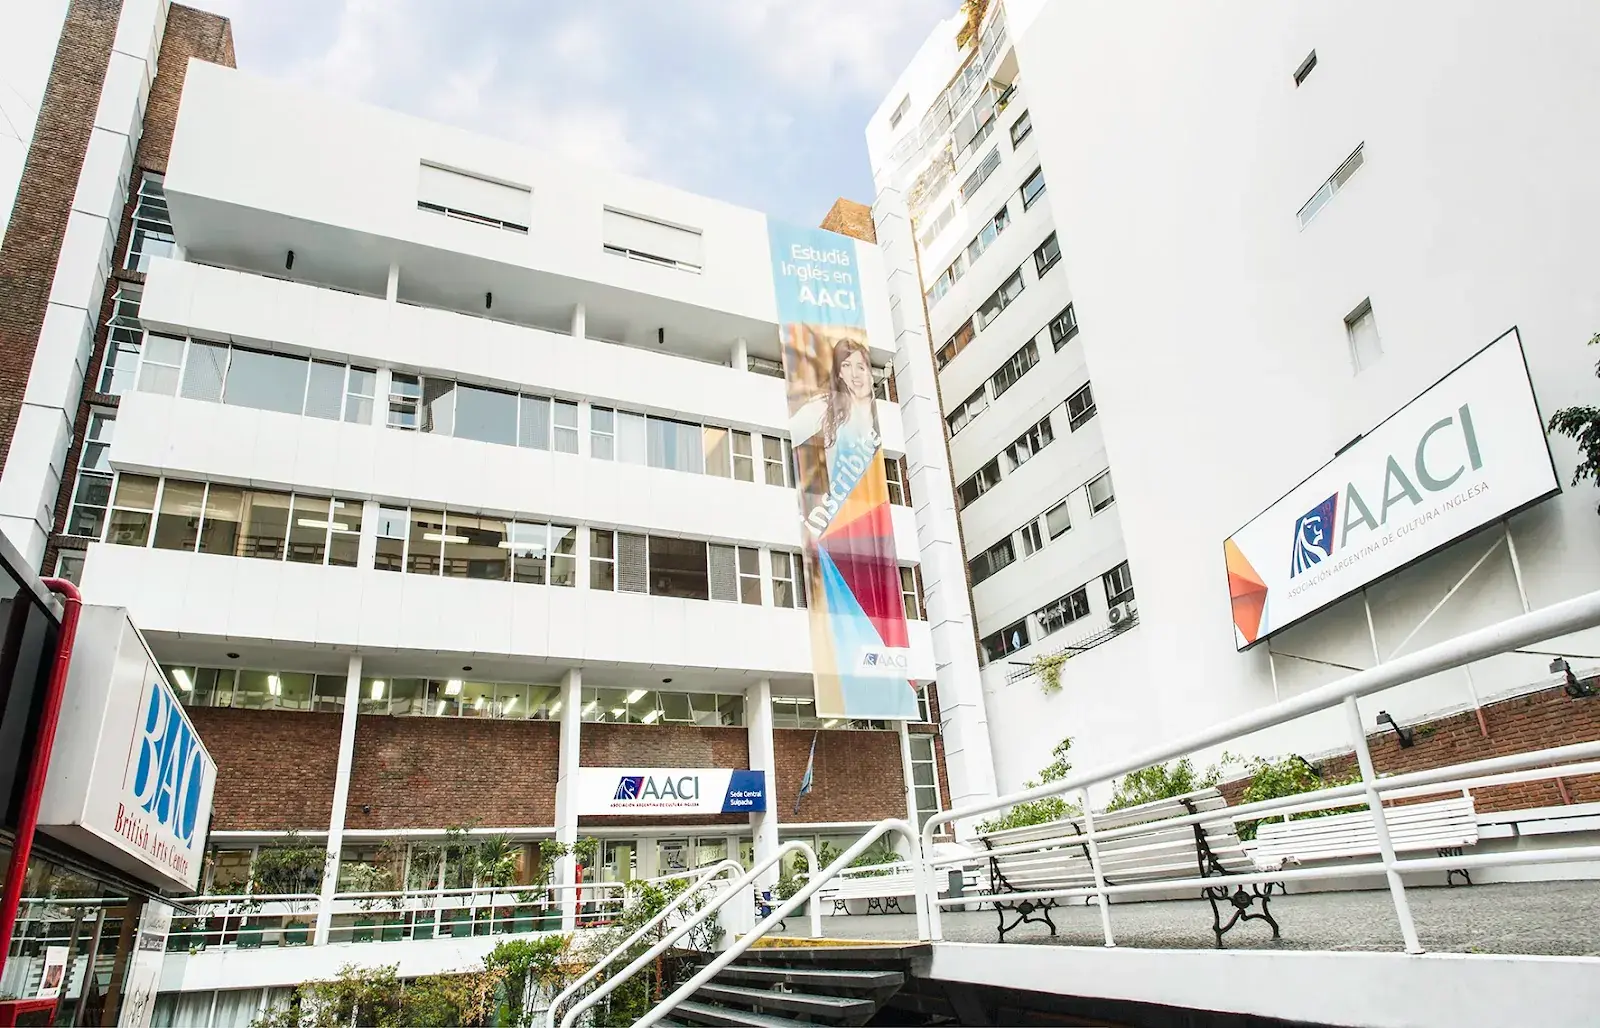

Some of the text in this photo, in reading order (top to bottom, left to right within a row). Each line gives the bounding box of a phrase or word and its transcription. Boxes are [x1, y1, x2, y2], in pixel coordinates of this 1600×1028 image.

[791, 243, 850, 266] Estudiá
[781, 261, 852, 285] Inglés en
[800, 286, 856, 310] AACI
[1341, 403, 1483, 548] AACI
[1288, 481, 1489, 599] ASOCIACIÓN ARGENTINA DE CULTURA INGLESA
[878, 653, 908, 668] AACI
[641, 776, 699, 800] AACI
[743, 790, 762, 798] Central
[114, 802, 189, 876] British Arts Centre
